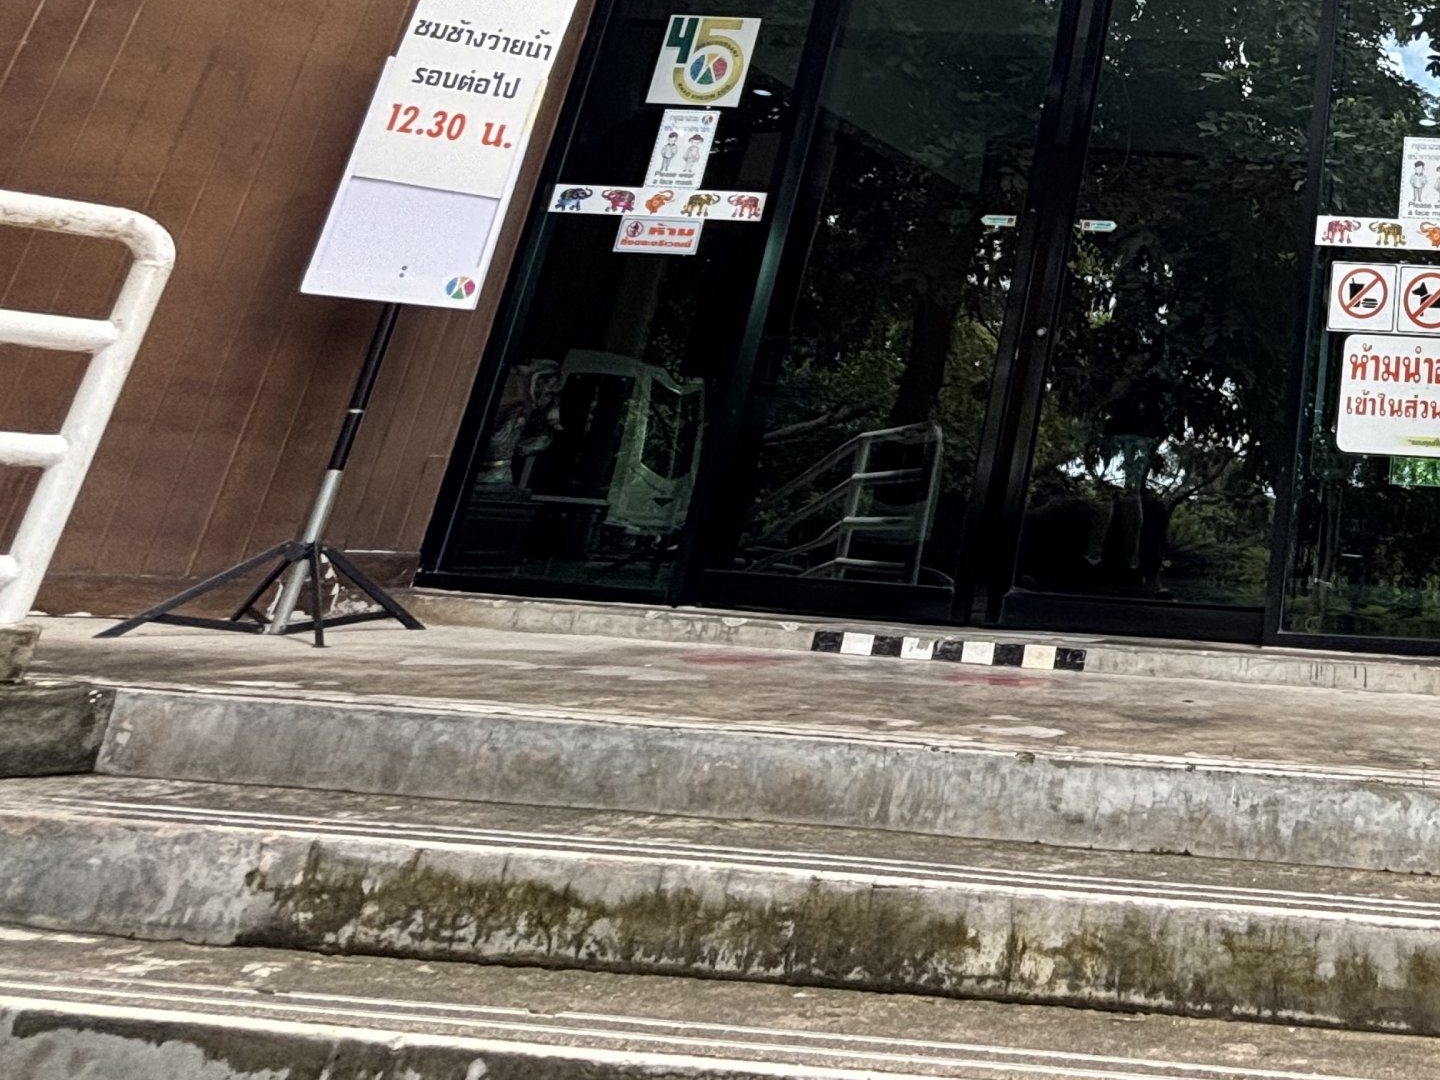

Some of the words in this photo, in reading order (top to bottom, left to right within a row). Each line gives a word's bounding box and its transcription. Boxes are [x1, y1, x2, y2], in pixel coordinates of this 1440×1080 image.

[413, 19, 552, 61] ชมช้างว่ายน้ำ
[665, 17, 744, 104] 45
[411, 66, 521, 99] รอบต่อไป
[386, 103, 466, 141] 12.30
[481, 122, 512, 149] น.
[648, 222, 695, 237] ห้าม
